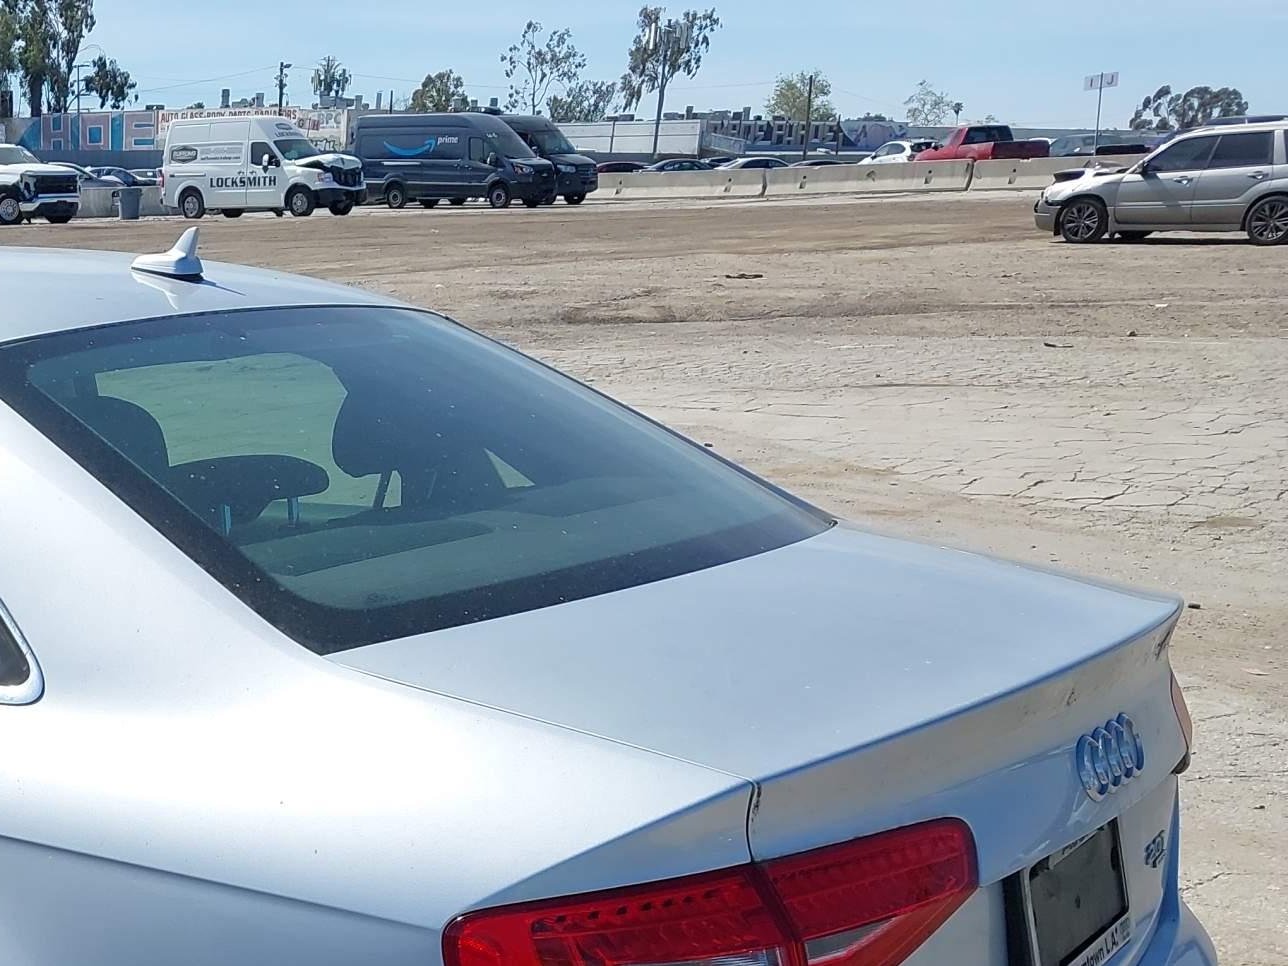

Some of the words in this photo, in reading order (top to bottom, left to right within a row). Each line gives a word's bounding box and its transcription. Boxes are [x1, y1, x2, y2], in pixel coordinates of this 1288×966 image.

[161, 112, 179, 122] AUTO
[437, 135, 459, 146] prime
[210, 175, 277, 188] LOCKSMITH
